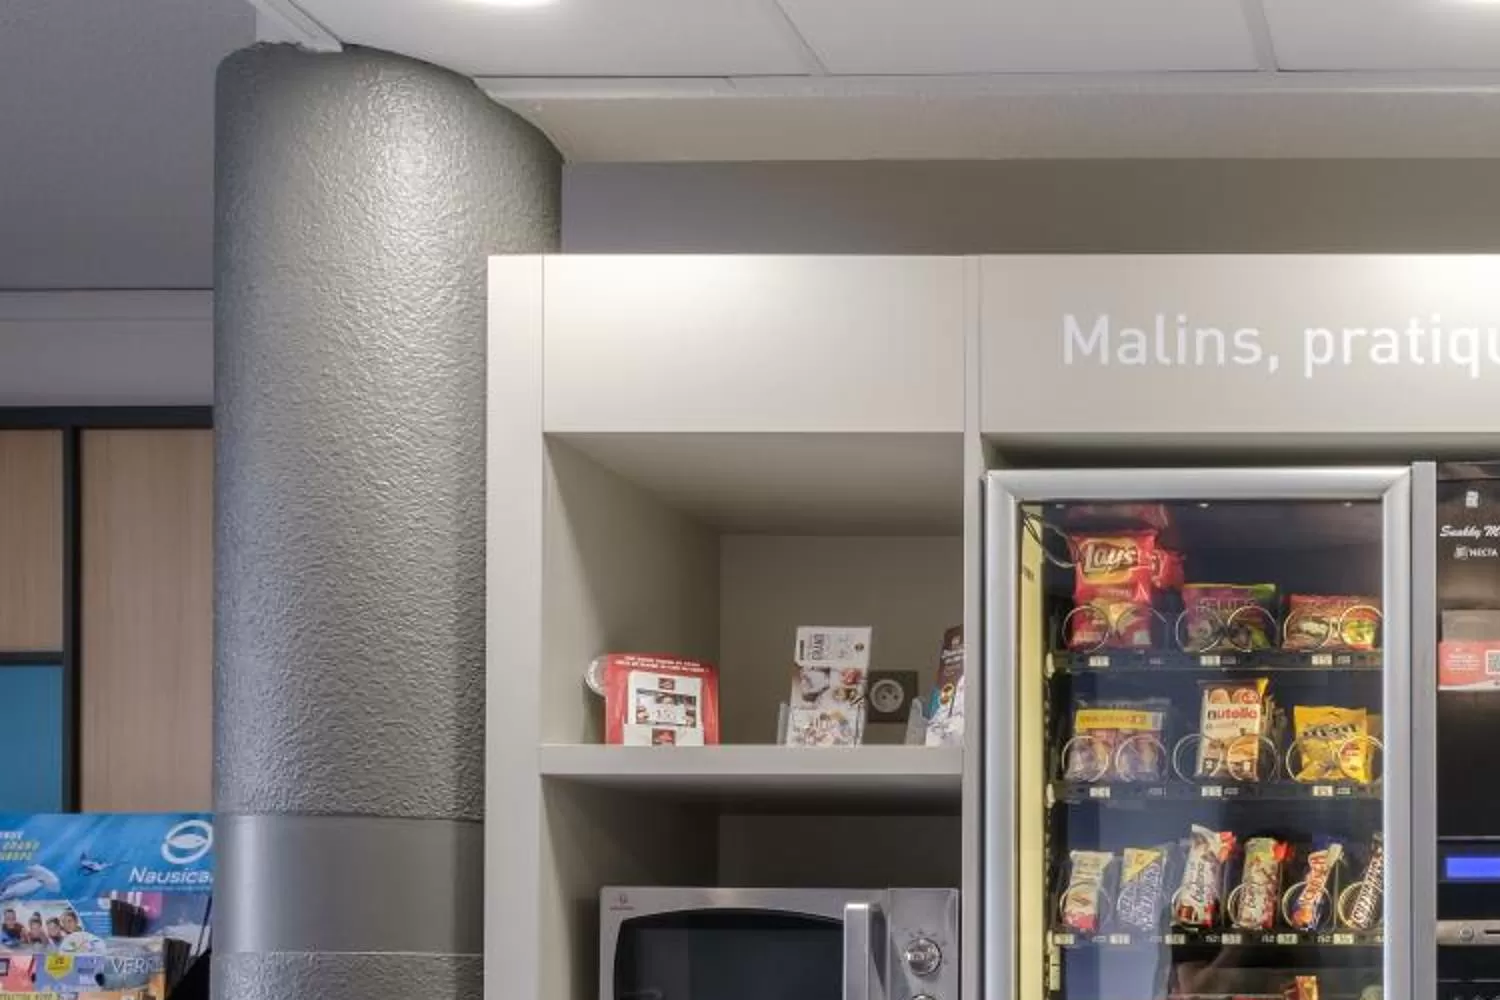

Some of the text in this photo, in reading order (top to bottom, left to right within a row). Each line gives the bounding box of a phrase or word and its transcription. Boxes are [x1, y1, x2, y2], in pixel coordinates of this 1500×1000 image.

[1063, 313, 1279, 374] Malins,
[1207, 707, 1258, 720] nutella
[128, 865, 213, 884] Nausica
